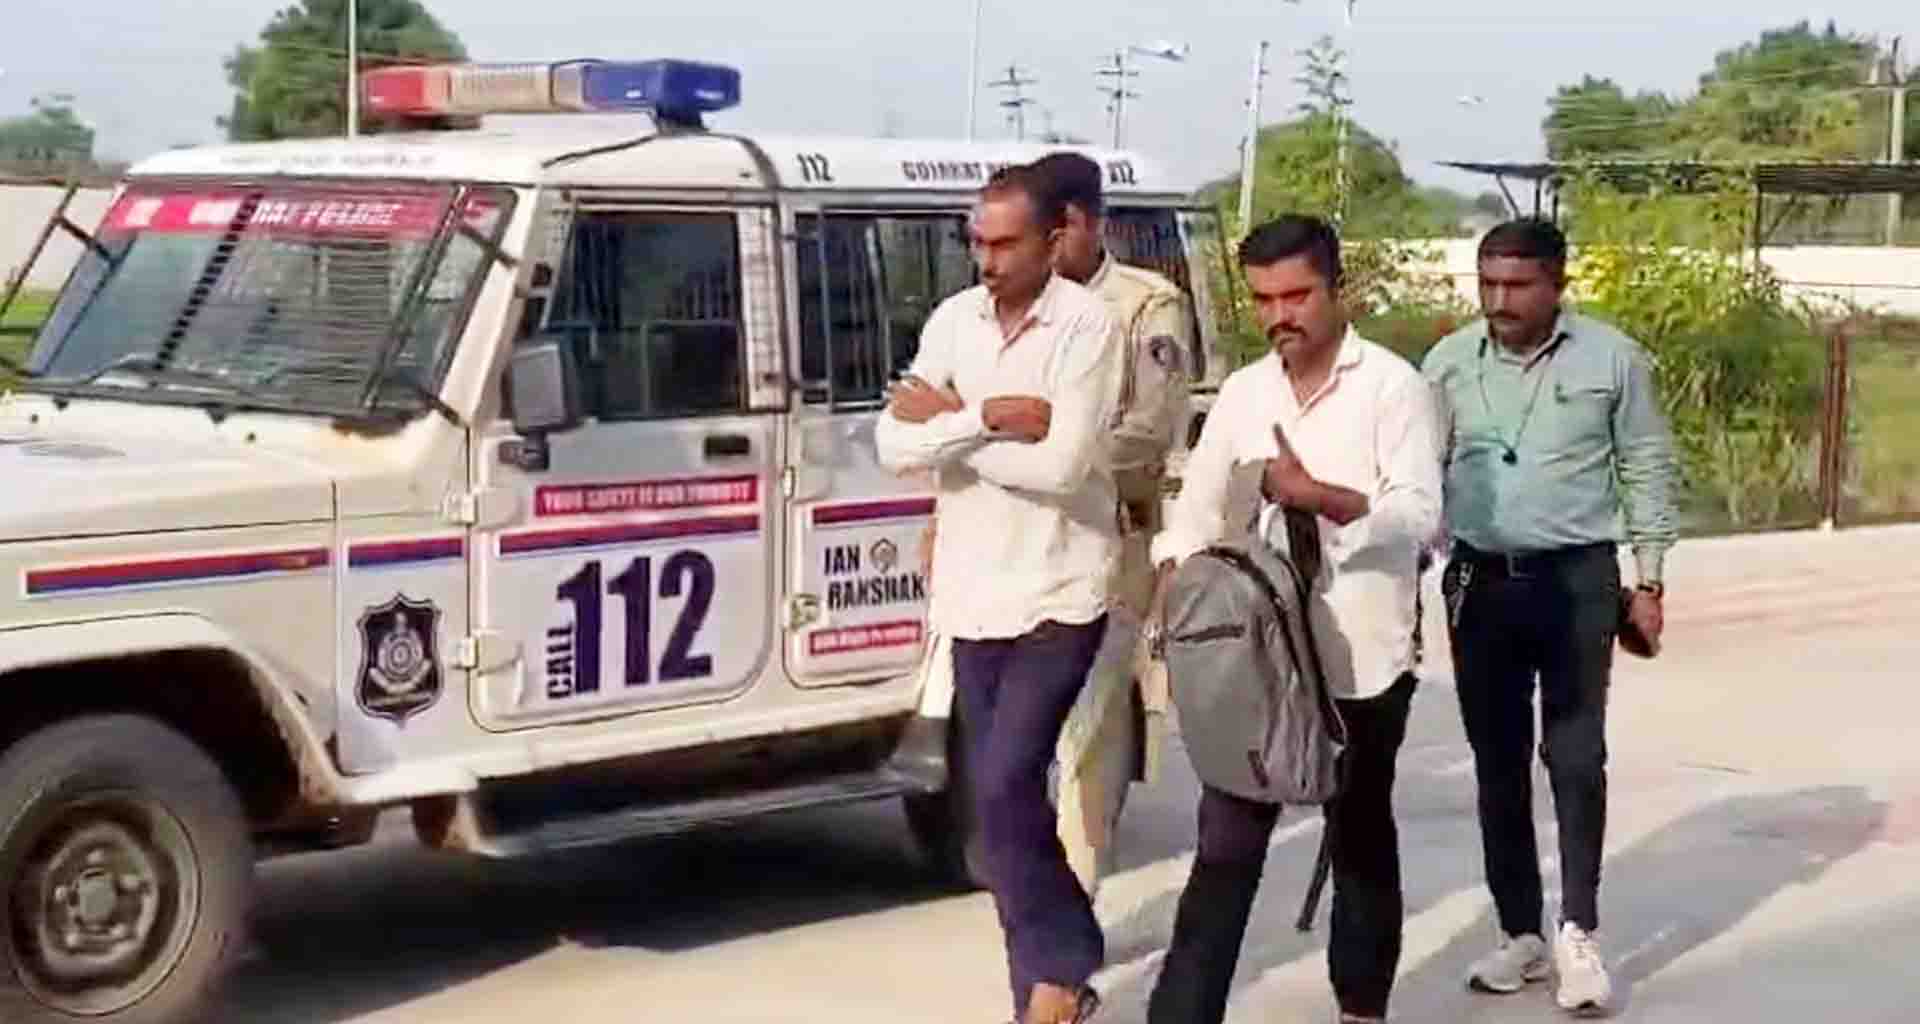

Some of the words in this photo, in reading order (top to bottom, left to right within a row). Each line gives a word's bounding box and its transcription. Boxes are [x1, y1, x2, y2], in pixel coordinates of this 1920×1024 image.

[798, 153, 834, 182] 112
[828, 571, 925, 611] RAKSHAK
[557, 549, 715, 694] 112
[546, 623, 573, 700] CALL
